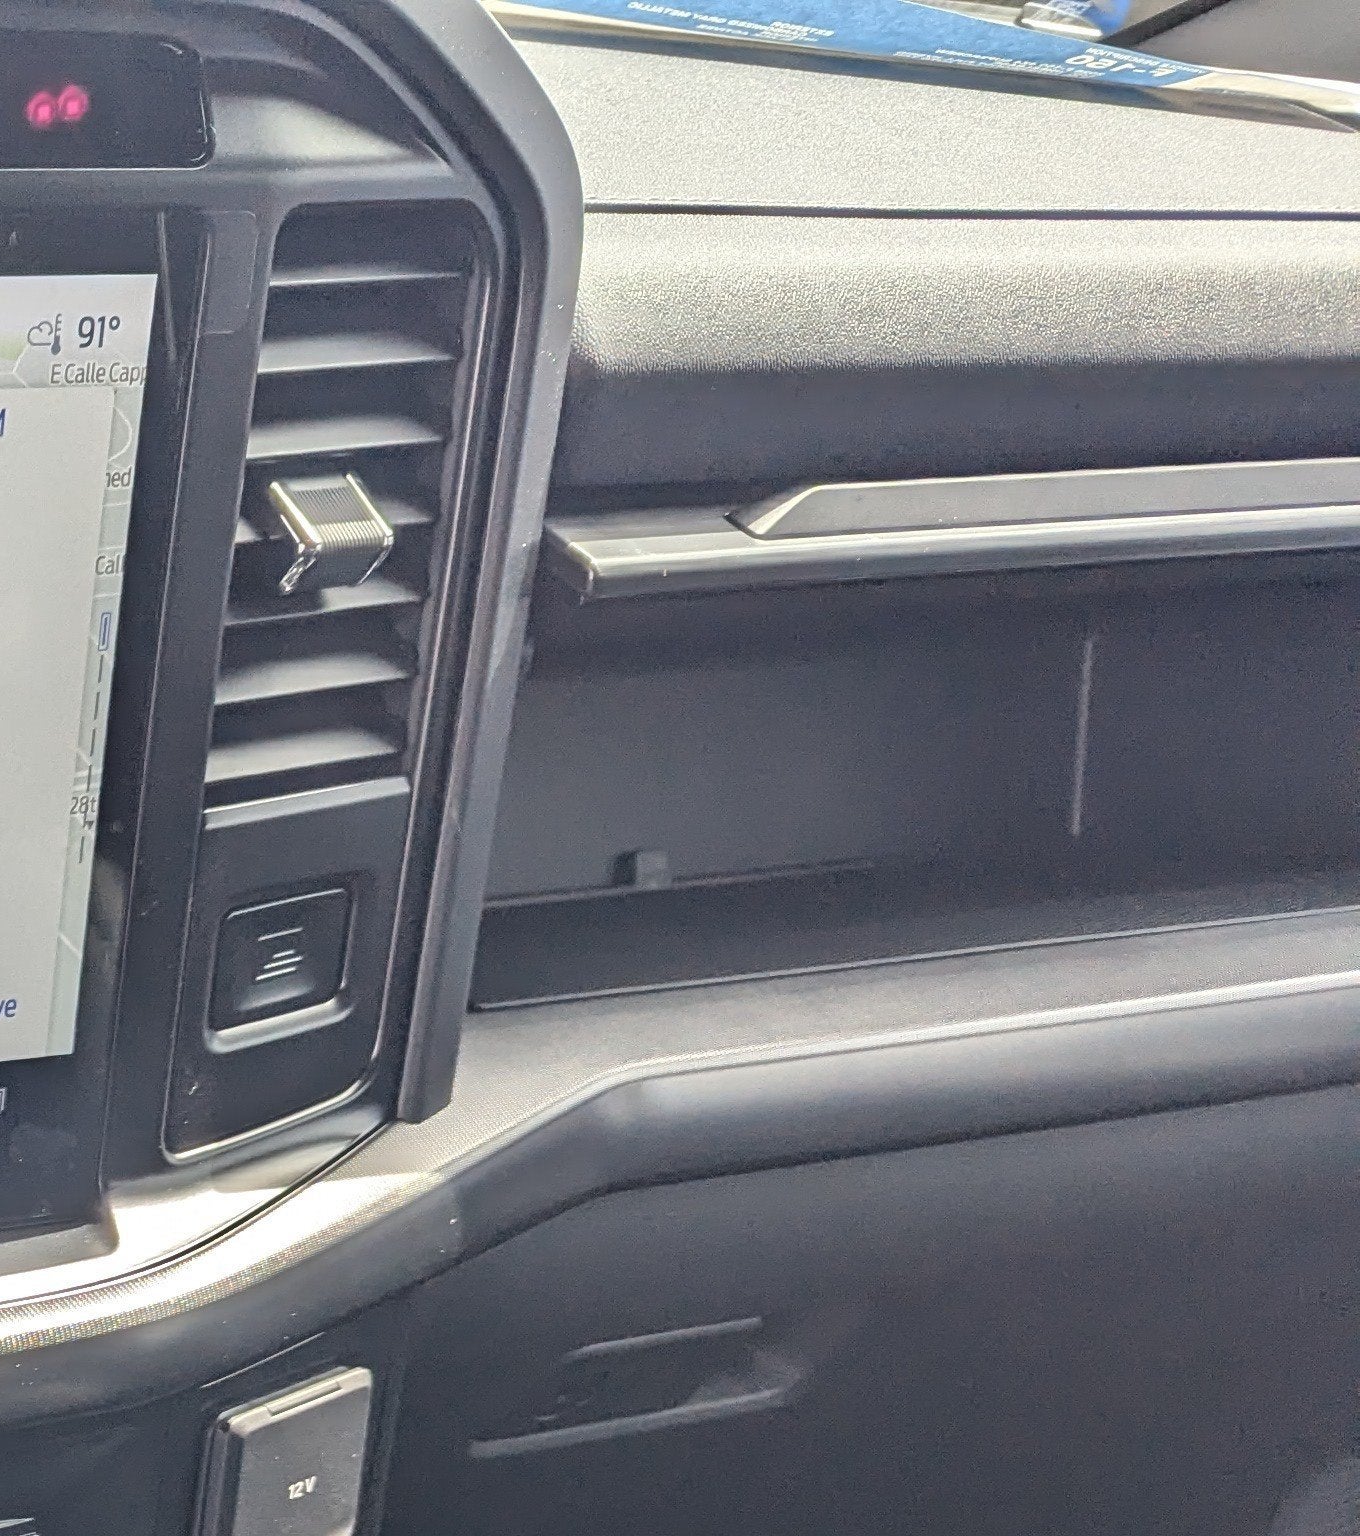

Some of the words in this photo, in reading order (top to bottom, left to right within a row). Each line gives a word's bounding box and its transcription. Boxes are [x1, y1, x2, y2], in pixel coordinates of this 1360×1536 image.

[51, 364, 62, 385] E
[63, 362, 106, 384] Calle
[288, 1475, 317, 1500] 12V
